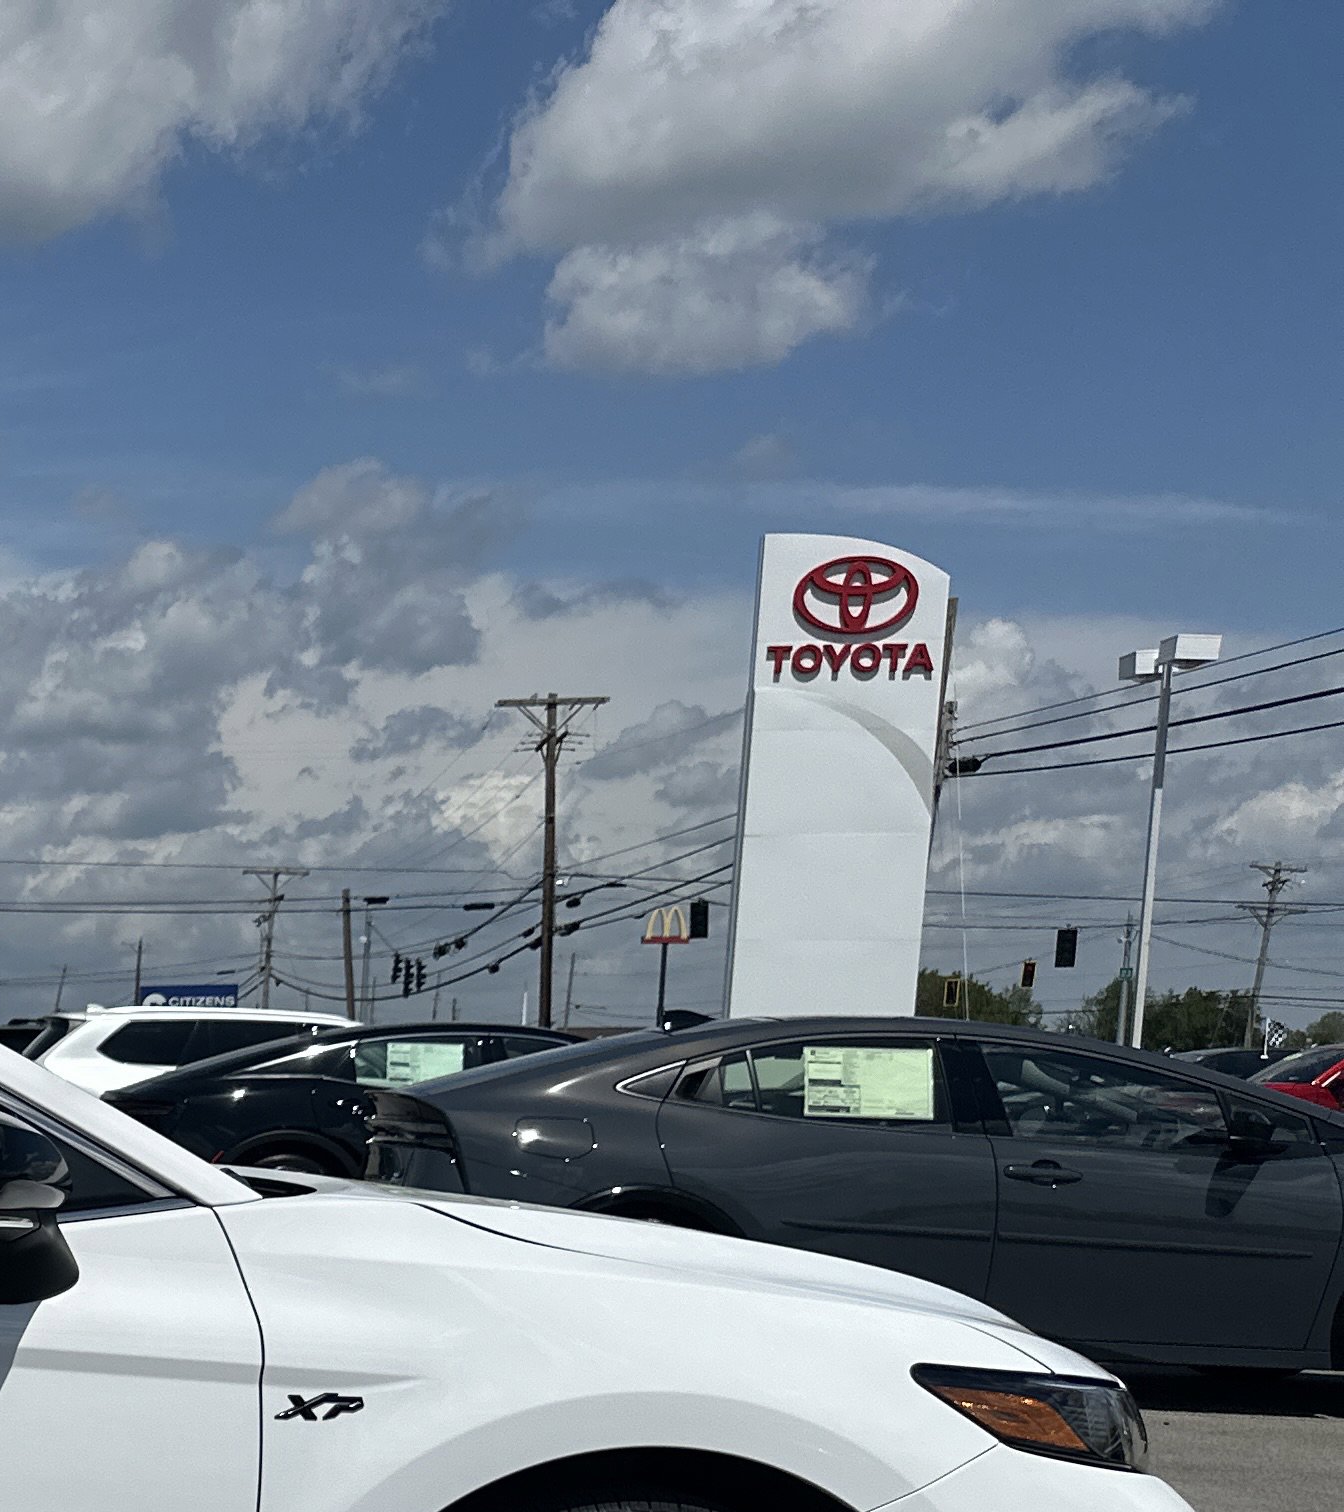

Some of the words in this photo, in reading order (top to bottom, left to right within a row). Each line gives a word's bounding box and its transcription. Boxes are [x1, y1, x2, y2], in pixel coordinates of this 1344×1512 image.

[766, 643, 934, 675] TOYOTA
[168, 995, 235, 1007] CITIZENS
[274, 1392, 364, 1421] XP
